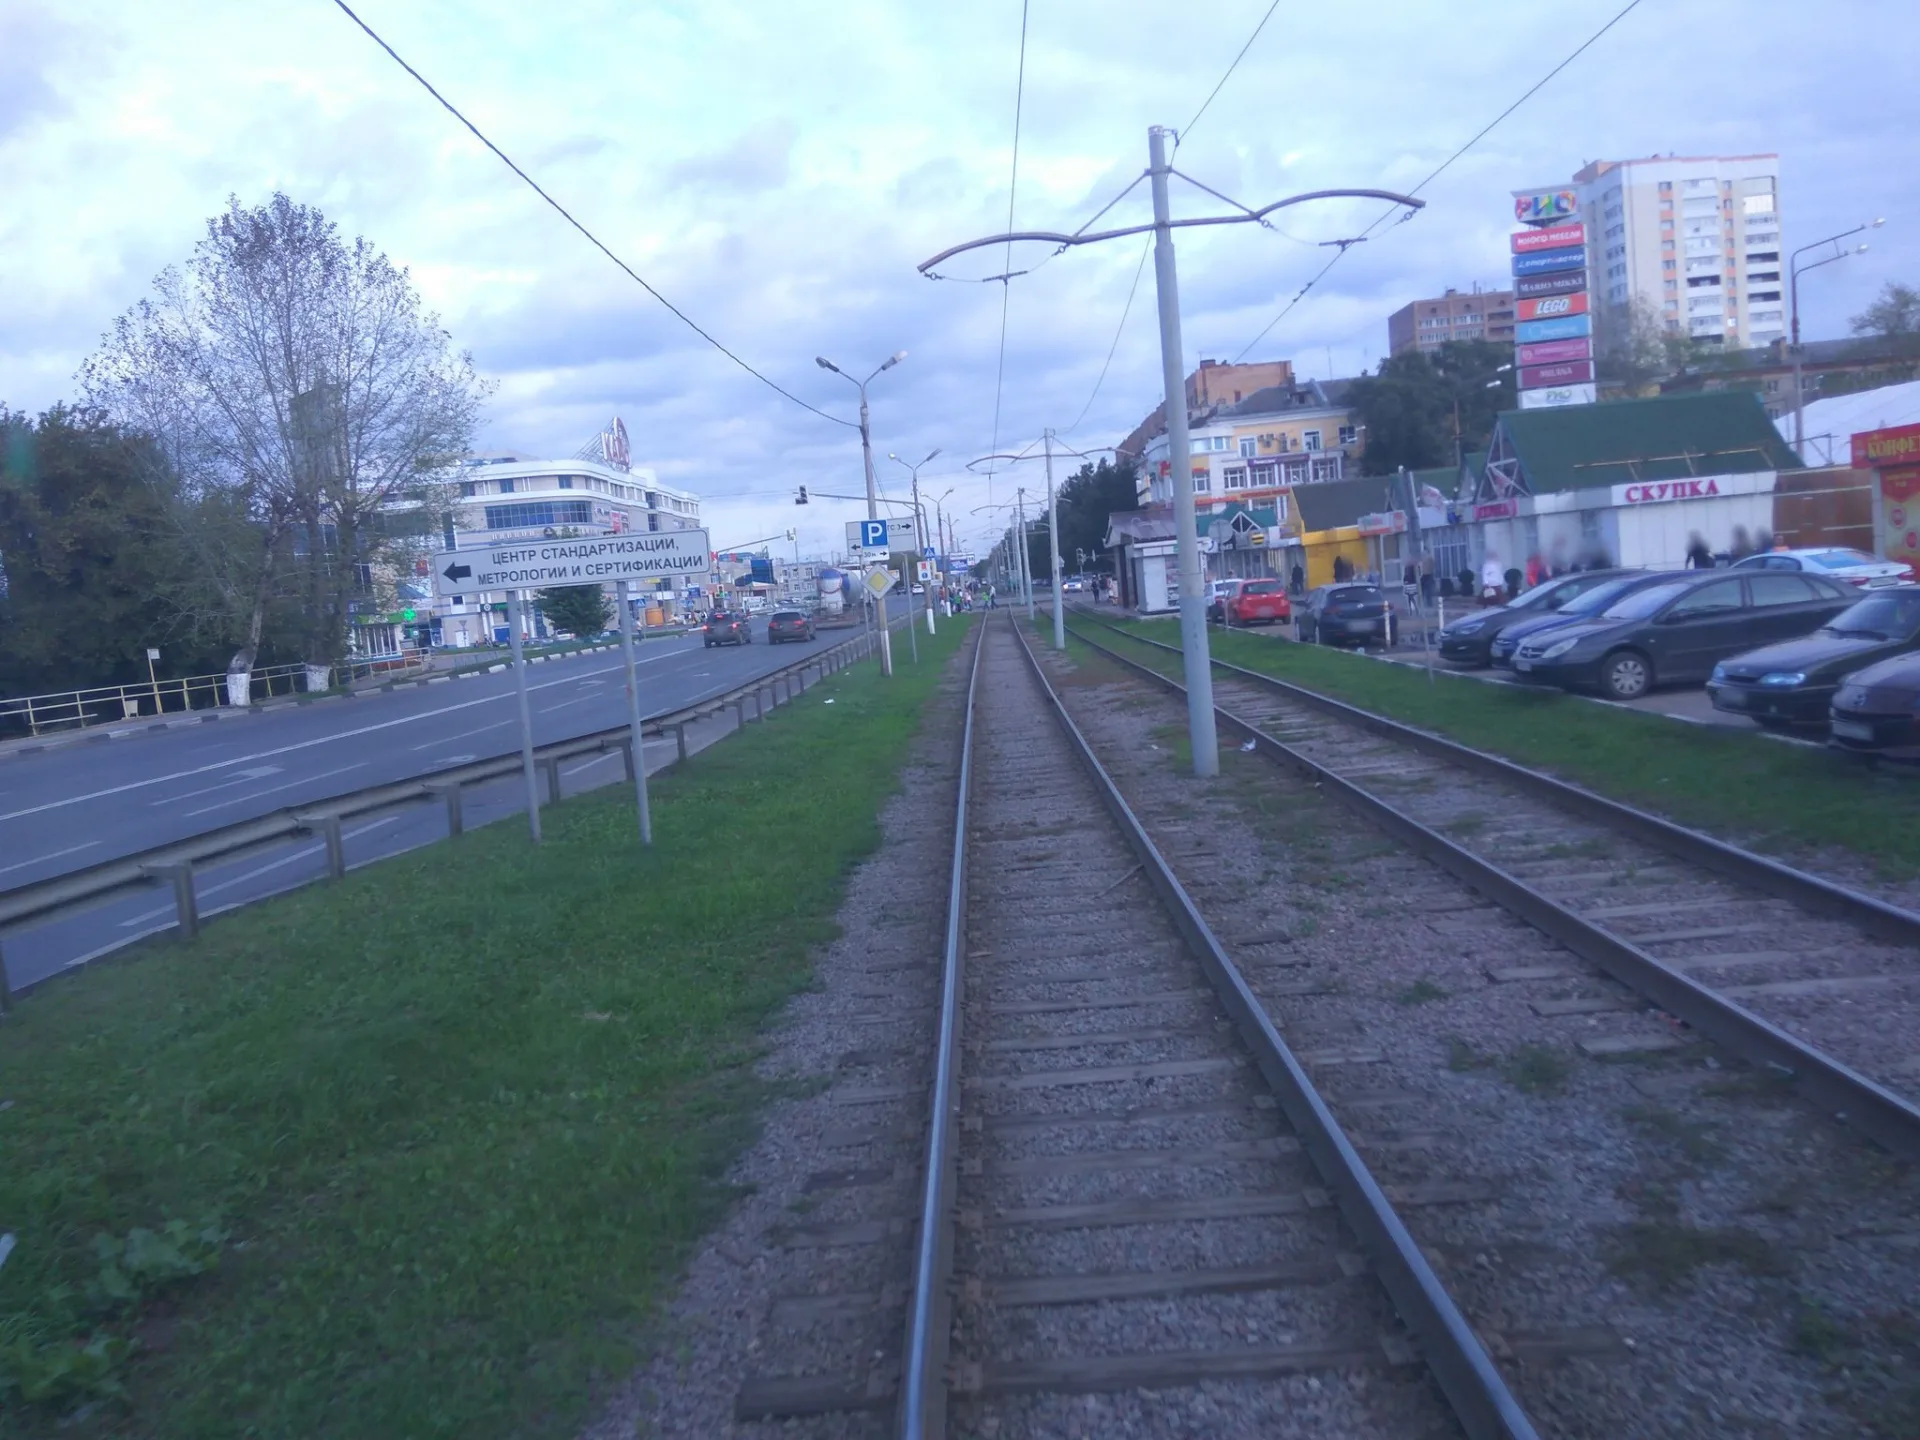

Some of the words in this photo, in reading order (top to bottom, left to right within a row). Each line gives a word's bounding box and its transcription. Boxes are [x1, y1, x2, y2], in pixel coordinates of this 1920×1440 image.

[1516, 190, 1576, 220] РИО
[1536, 298, 1570, 315] LEGO
[1868, 434, 1920, 459] КОНФЕ
[1625, 479, 1720, 502] СКУПКА
[492, 549, 537, 566] ЦЕНТР
[541, 538, 679, 561] СТАНДАРТИЗАЦИИ,
[478, 566, 568, 586] МЕТРОЛОГИИ
[572, 565, 582, 577] И
[585, 555, 703, 576] СЕРТИФИКАЦИИ
